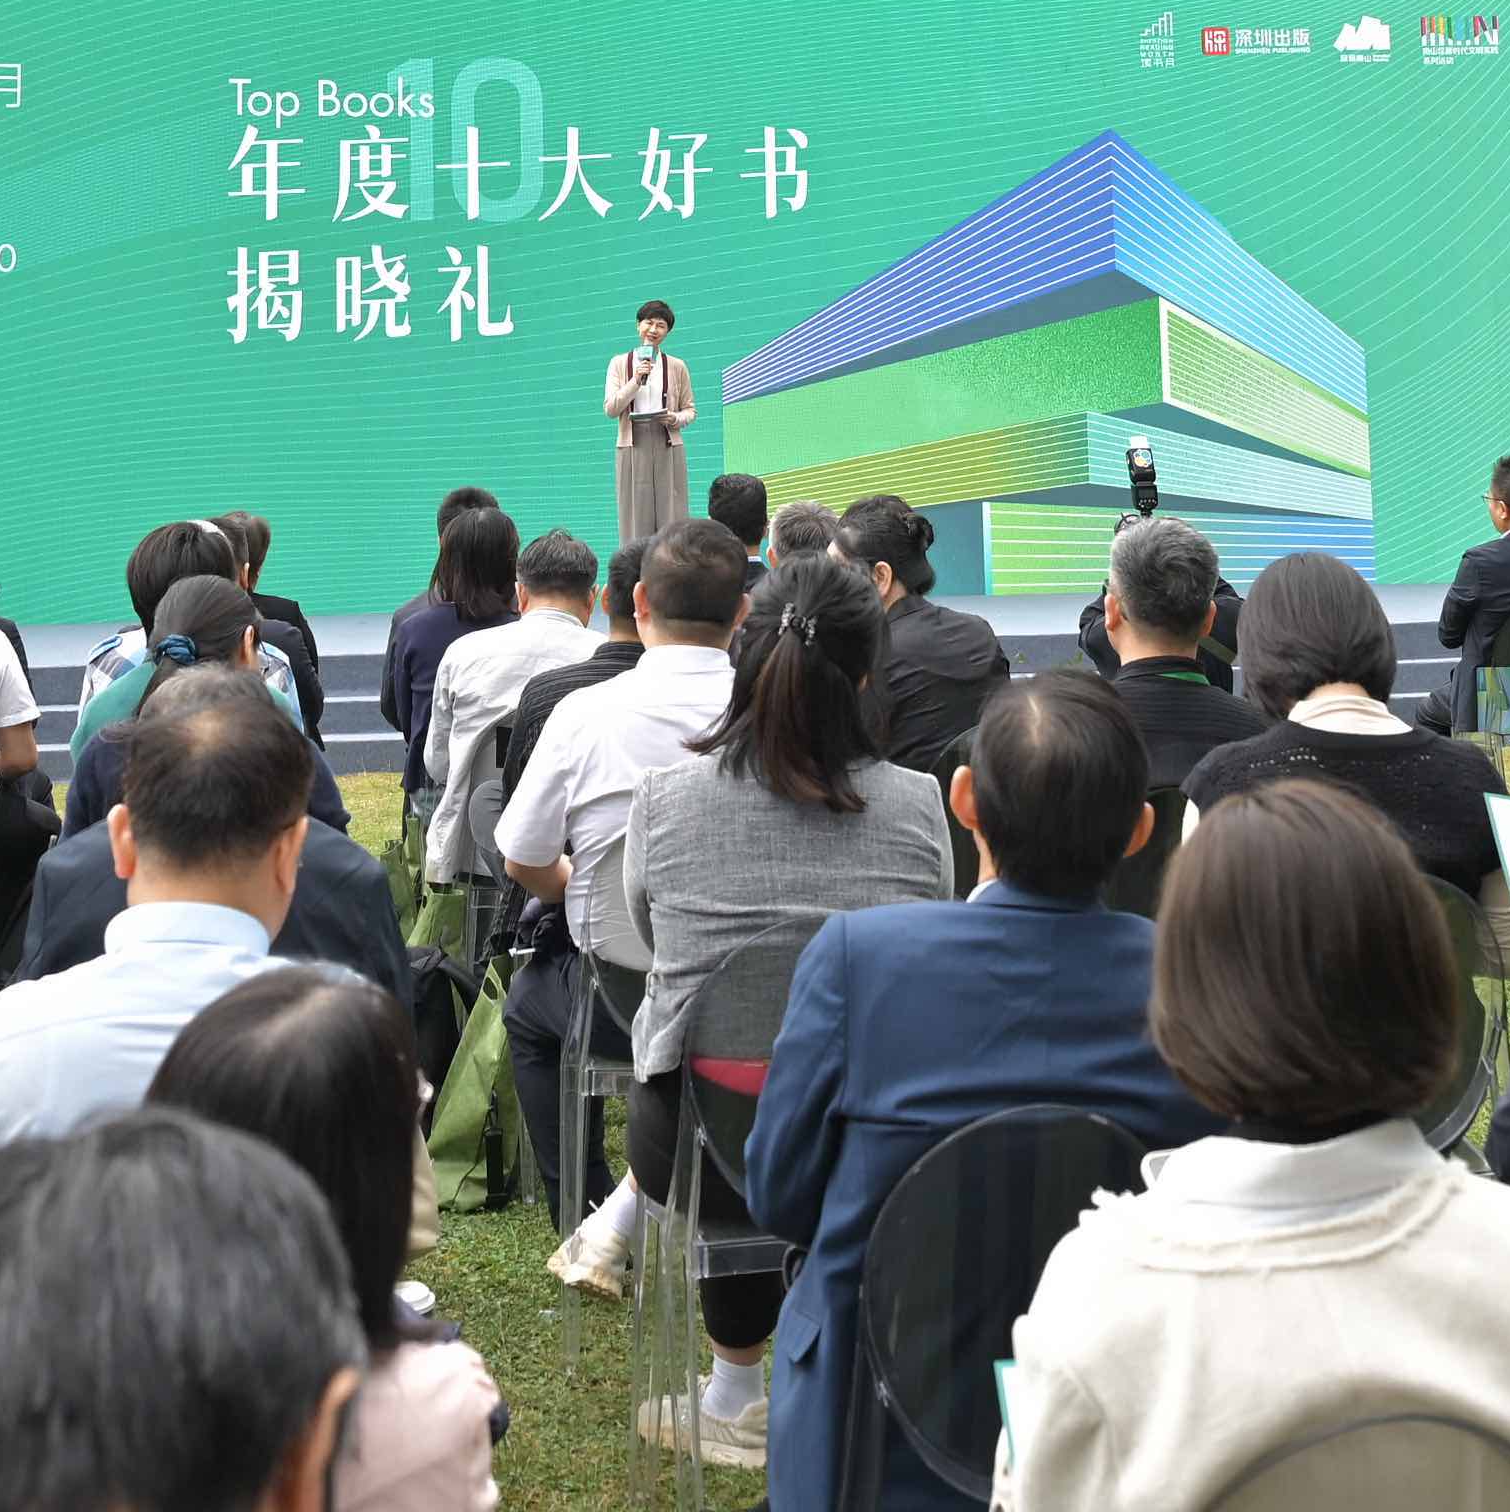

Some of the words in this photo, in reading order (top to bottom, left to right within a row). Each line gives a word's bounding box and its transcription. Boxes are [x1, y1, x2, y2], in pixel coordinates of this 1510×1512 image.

[1235, 28, 1311, 48] 深圳出版
[228, 78, 300, 128] Top
[317, 76, 435, 119] Books
[227, 245, 514, 344] 揭晓礼
